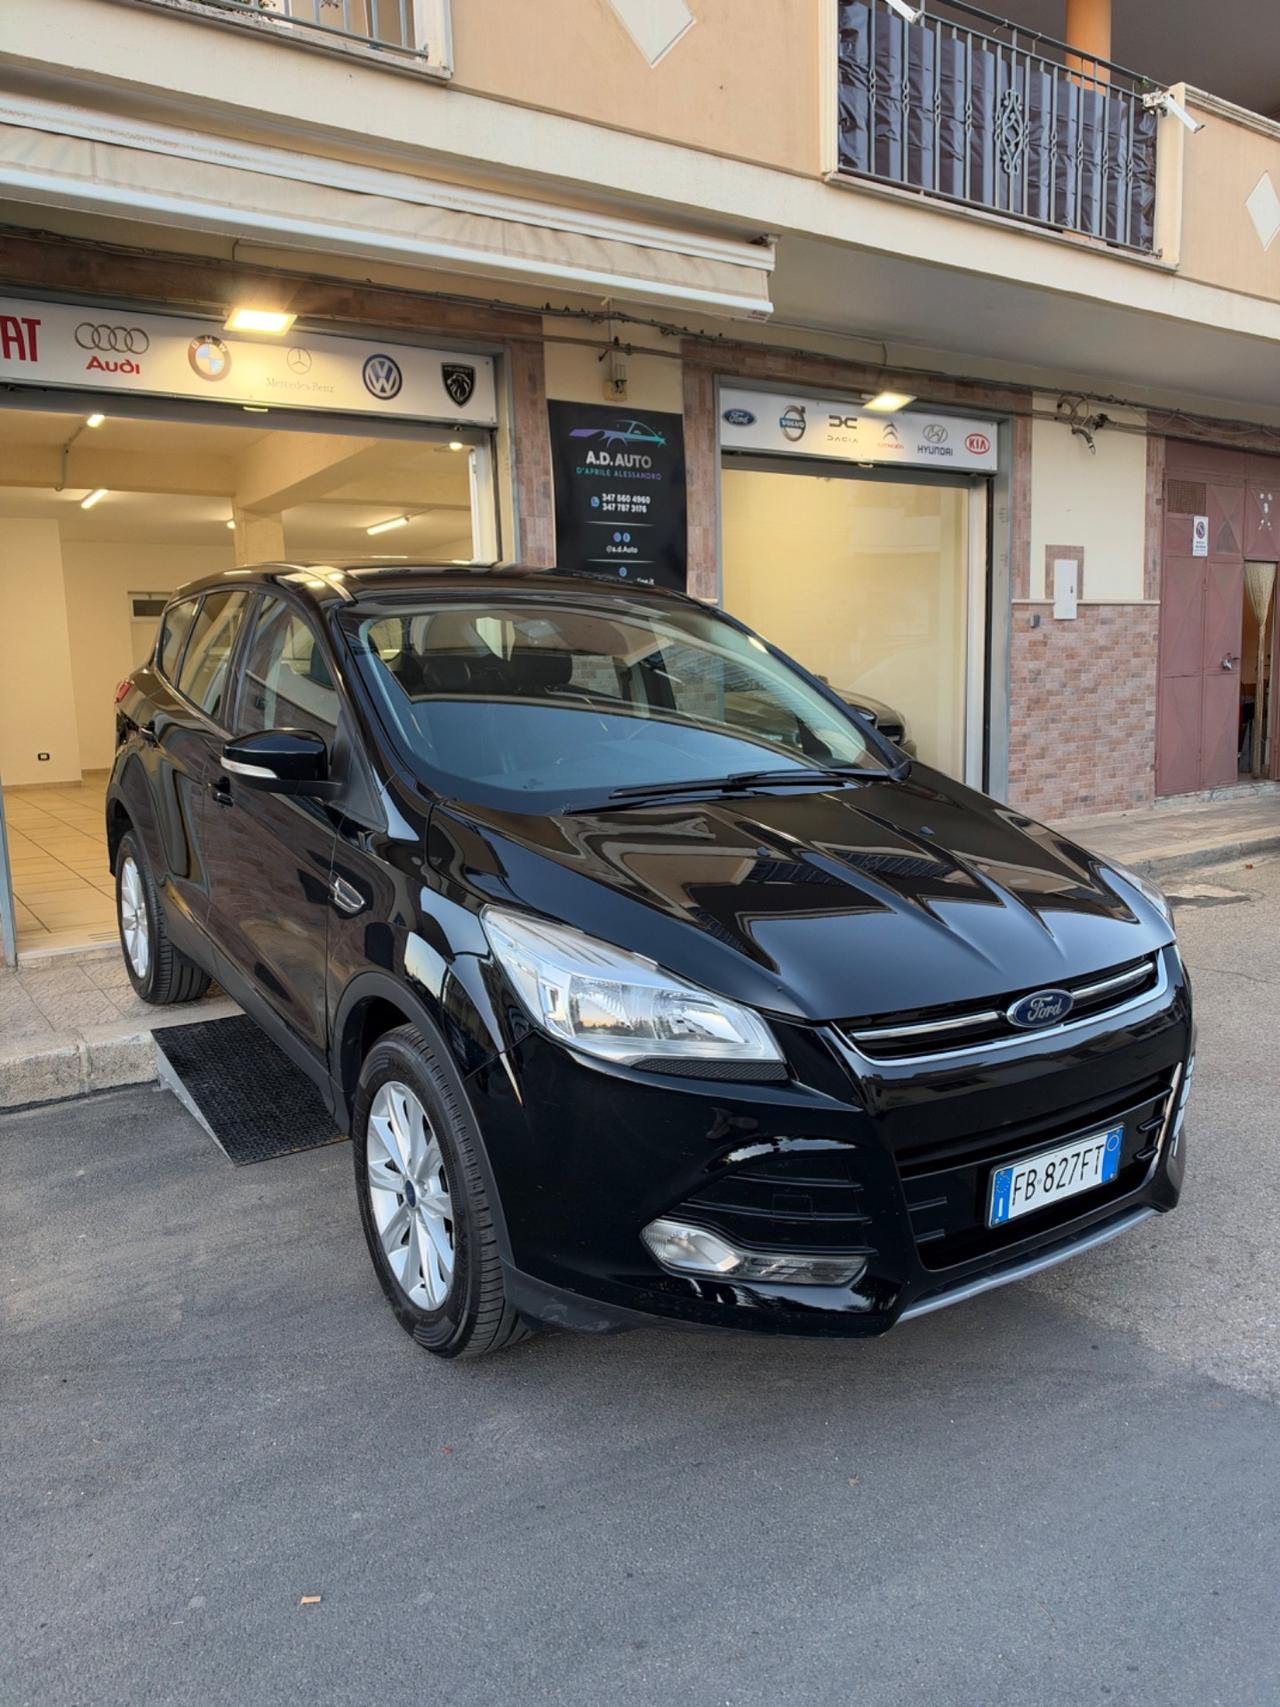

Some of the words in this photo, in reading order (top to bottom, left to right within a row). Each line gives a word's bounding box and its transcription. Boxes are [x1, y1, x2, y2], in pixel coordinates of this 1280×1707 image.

[86, 356, 140, 375] Audi
[729, 410, 750, 425] Ford
[781, 419, 805, 429] VOLVO
[826, 435, 858, 443] DACIA
[968, 439, 987, 450] KIA
[917, 445, 953, 457] HYUNDAI
[586, 450, 613, 466] A.D.
[615, 453, 652, 469] AUTO
[575, 466, 611, 477] D'APRILE
[613, 469, 662, 481] ALESSANDRO
[602, 493, 616, 502] 347
[602, 502, 616, 511] 347
[1028, 996, 1062, 1021] Ford
[1012, 1168, 1037, 1206] FB
[1043, 1144, 1105, 1193] 827FT
